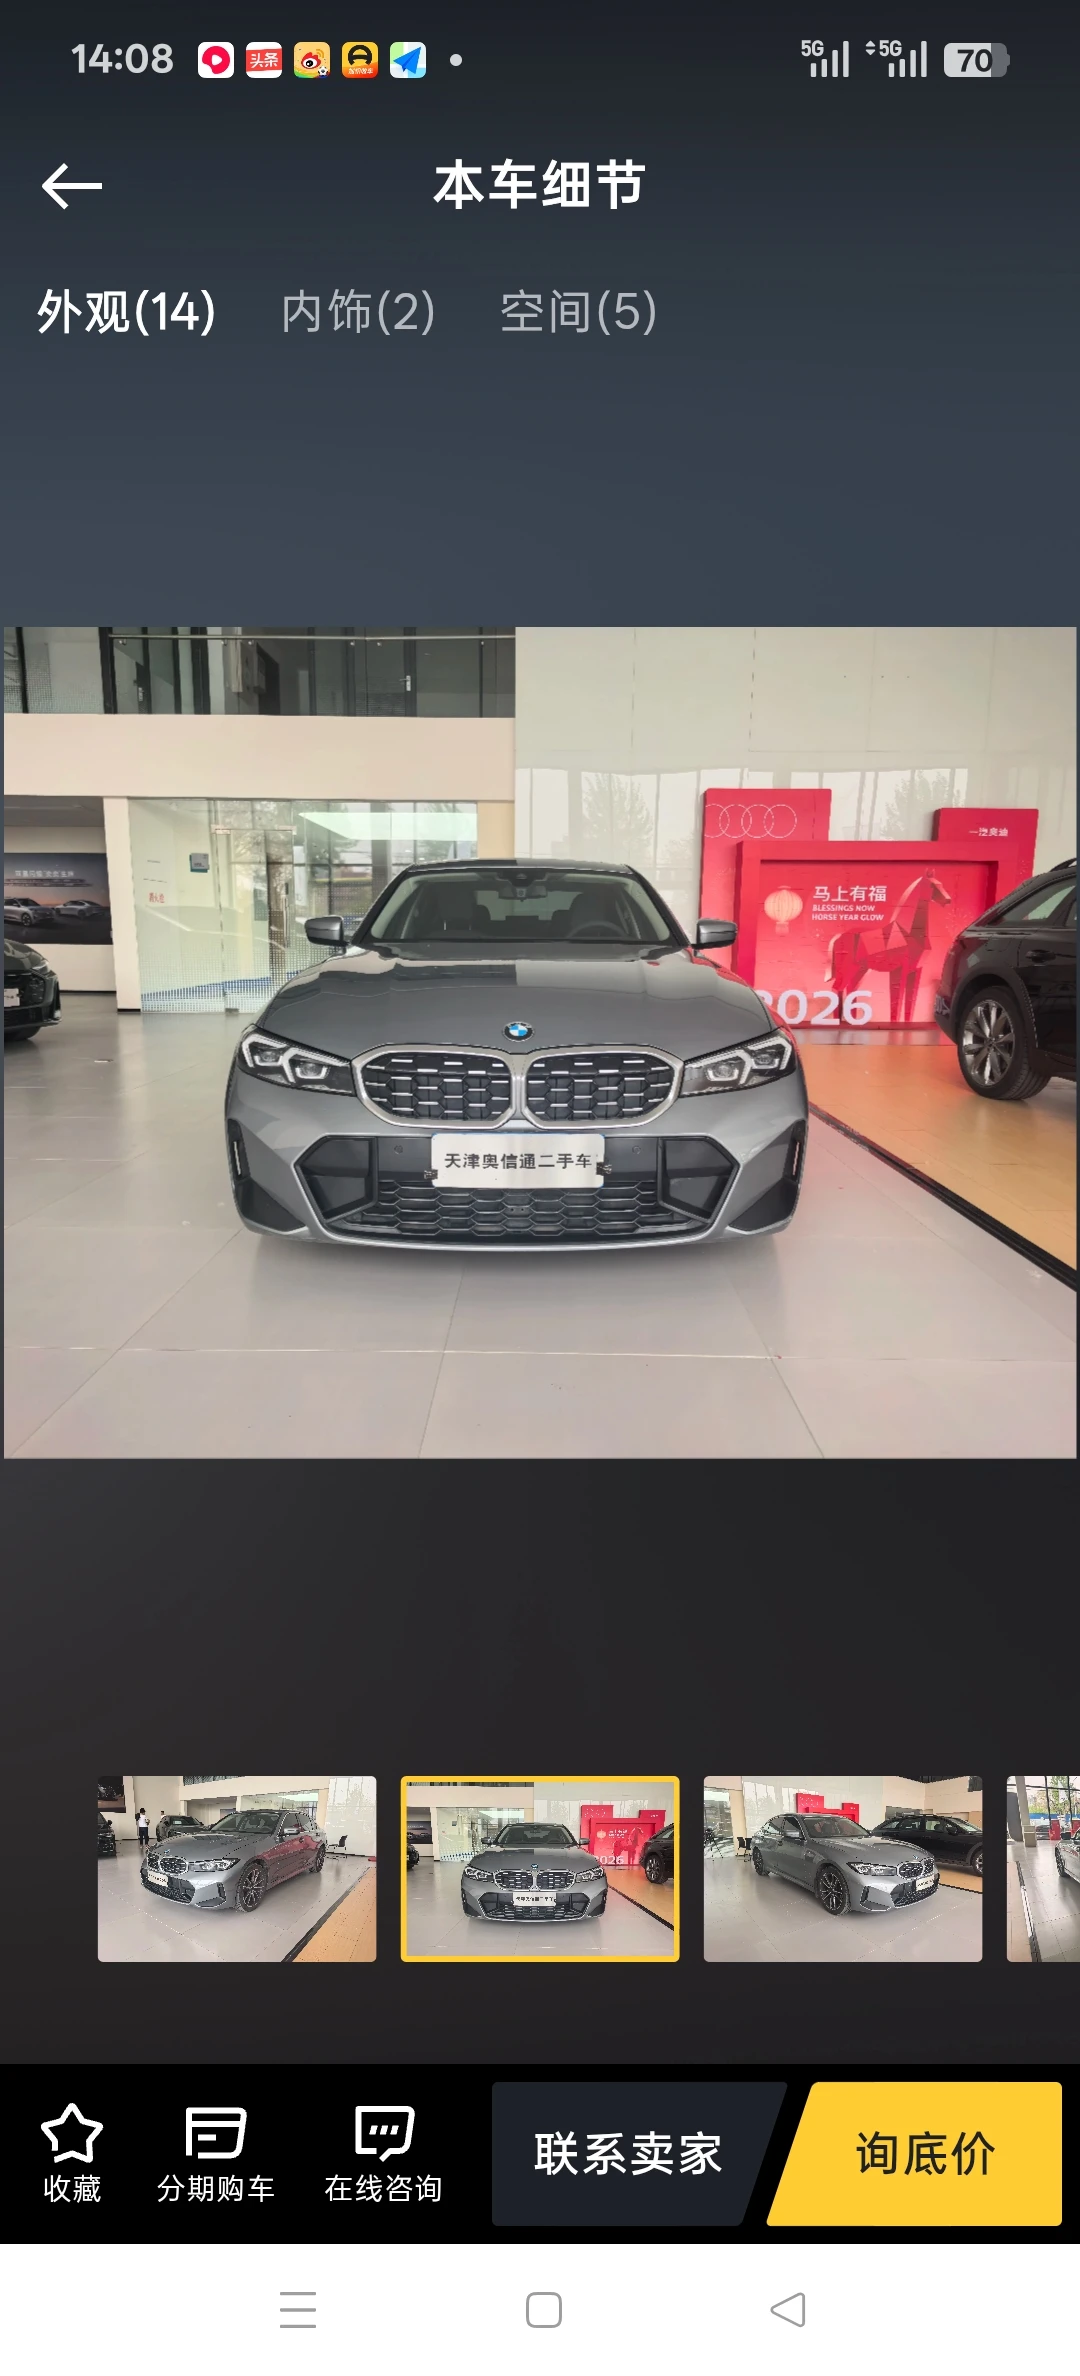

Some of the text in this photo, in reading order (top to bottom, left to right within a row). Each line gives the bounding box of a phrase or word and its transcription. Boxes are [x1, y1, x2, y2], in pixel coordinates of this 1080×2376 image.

[72, 44, 174, 74] 14:08
[250, 52, 279, 69] 头条
[801, 40, 824, 57] 5G
[879, 40, 902, 57] 5G
[957, 49, 993, 73] 70
[433, 159, 646, 209] 本车细节
[37, 289, 215, 336] 外观(14)
[283, 289, 434, 336] 内饰(2)
[501, 289, 656, 336] 空间(5)
[968, 827, 1008, 837] 一汽奥迪
[812, 904, 854, 912] BLESSINGS
[813, 885, 888, 902] 马上有福
[812, 913, 837, 921] HORSE
[860, 914, 884, 922] GLOW
[444, 1153, 593, 1170] 天津奥信通二手车
[534, 2130, 723, 2176] 联系卖家
[857, 2130, 996, 2176] 询底价
[43, 2174, 102, 2204] 收藏
[157, 2174, 275, 2203] 分期购车
[325, 2174, 442, 2203] 在线咨询
